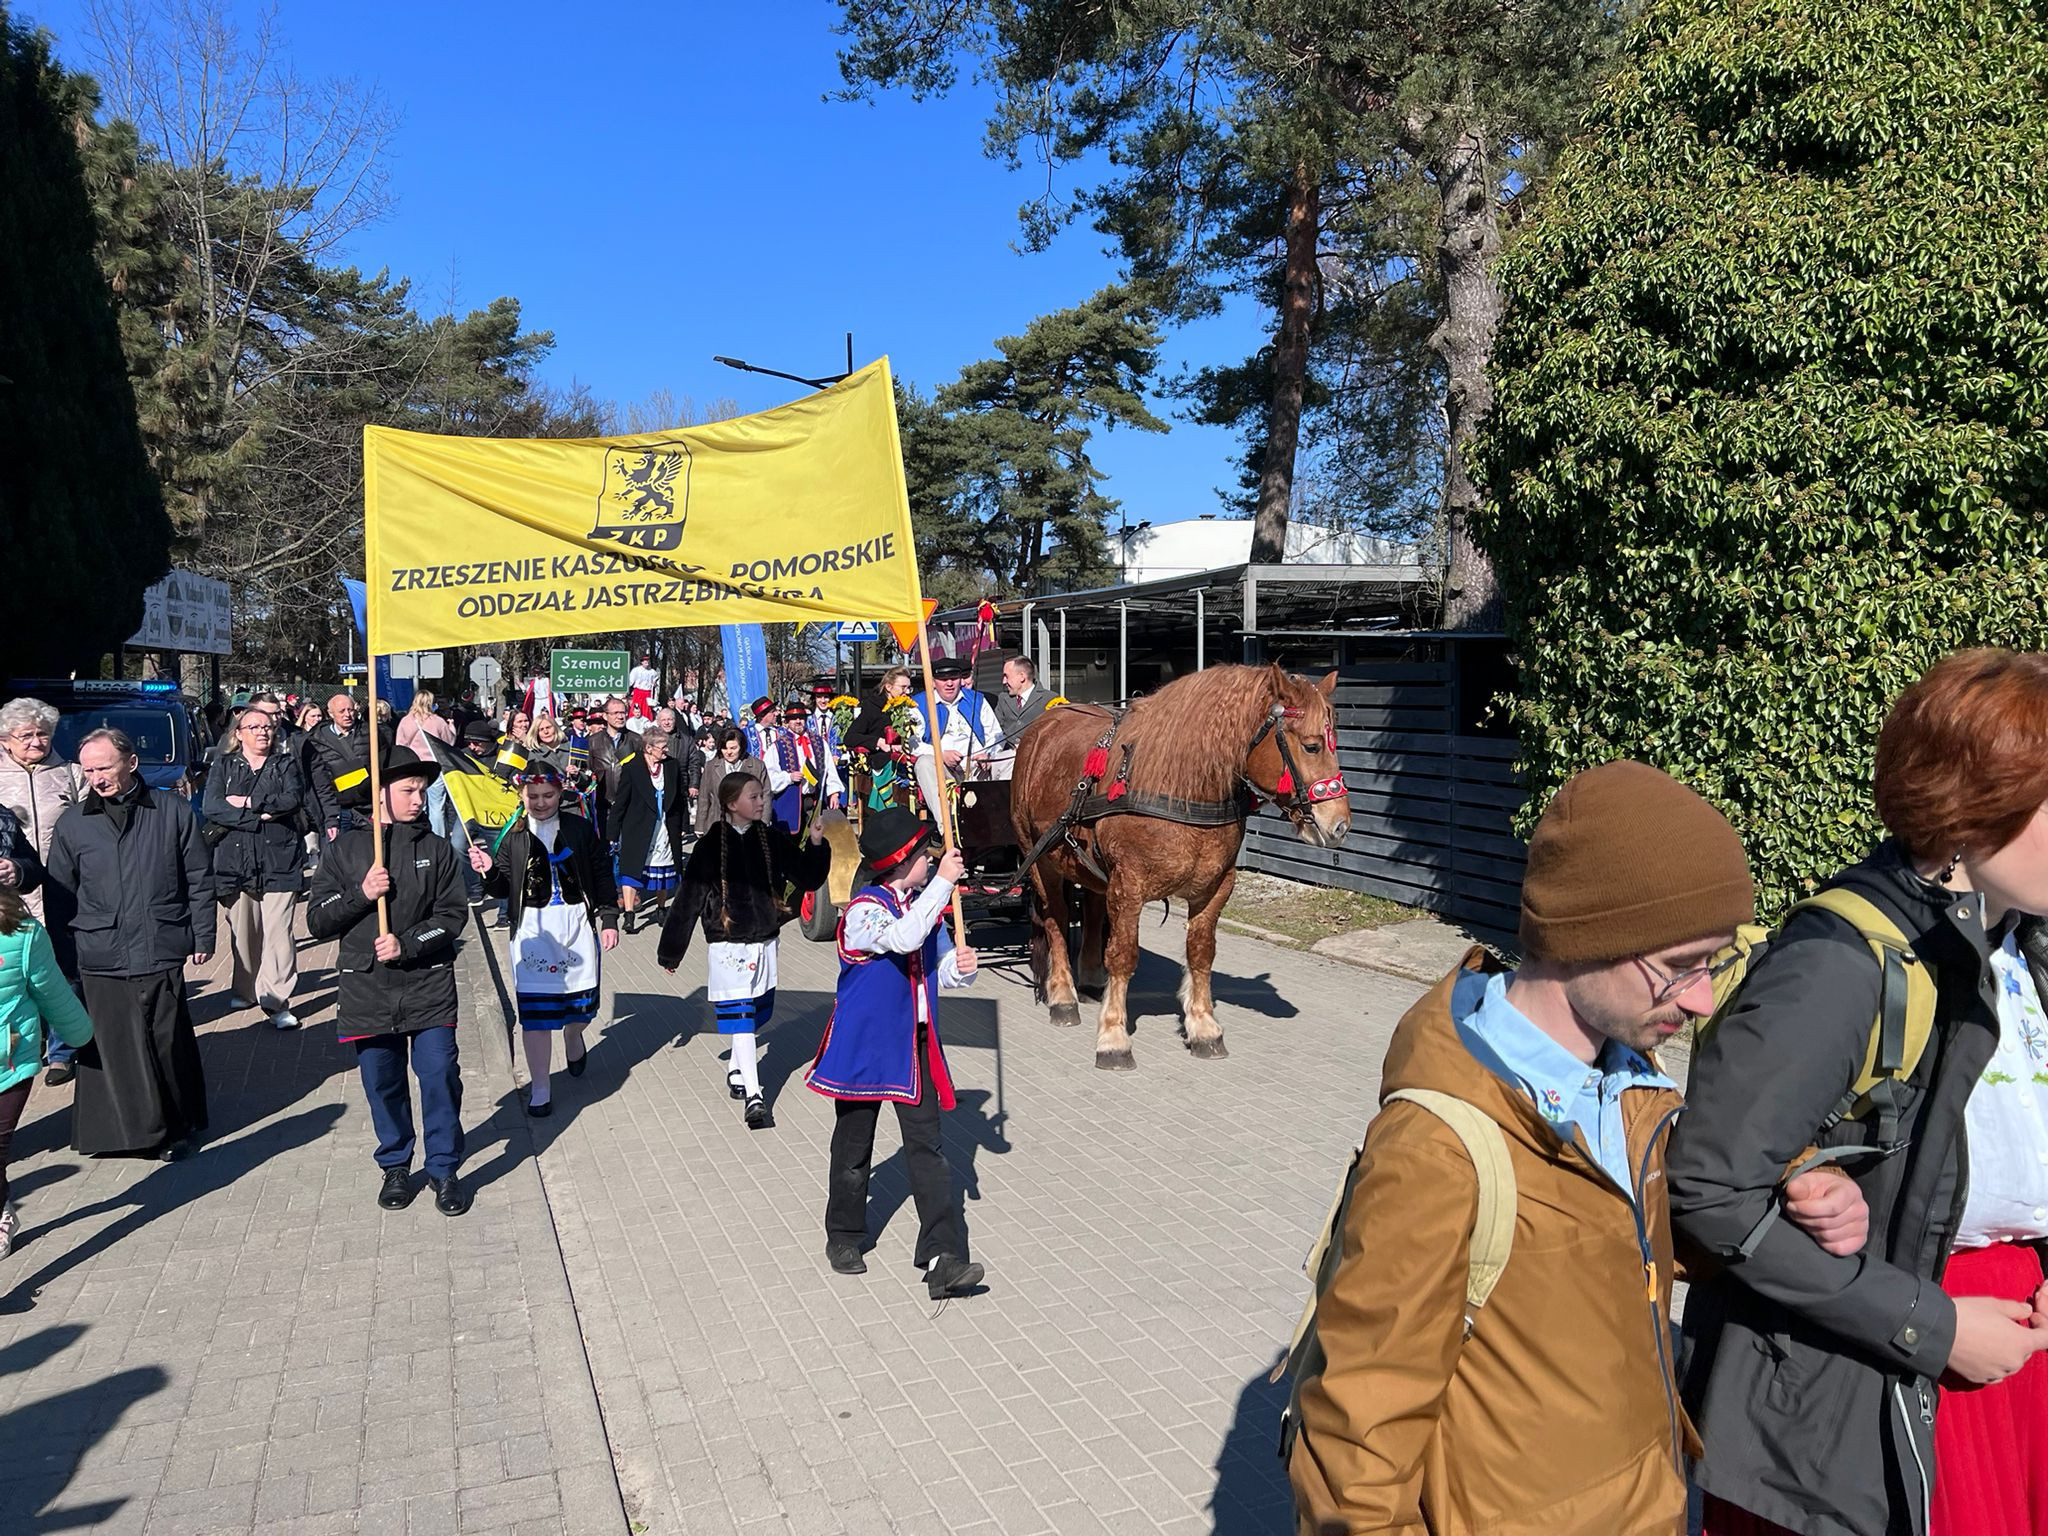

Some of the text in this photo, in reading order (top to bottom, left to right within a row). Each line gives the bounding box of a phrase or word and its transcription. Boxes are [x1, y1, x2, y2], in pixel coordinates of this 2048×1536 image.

[608, 528, 668, 547] ZKP
[391, 557, 546, 592] ZRZESZENIE
[730, 532, 896, 583] POMORSKIE
[457, 589, 576, 619] ODDZIAŁ
[581, 579, 742, 610] JASTRZĘBIA
[561, 656, 621, 670] Szemud
[556, 674, 624, 688] Szëmôłd
